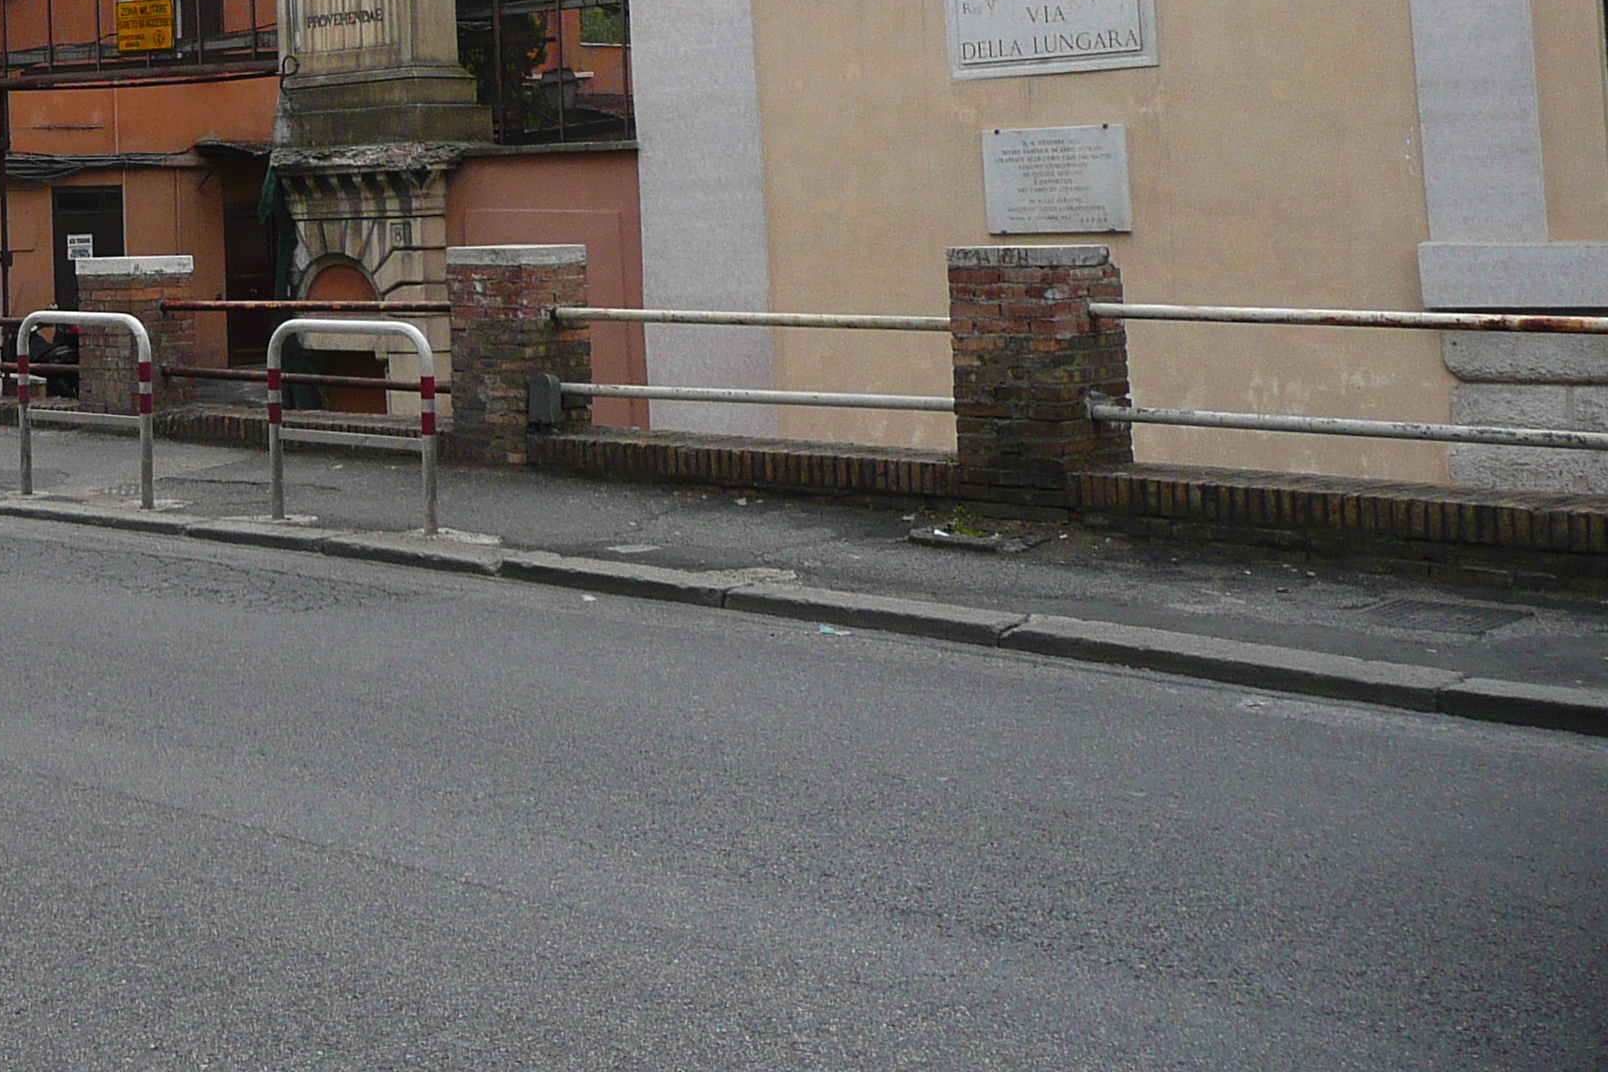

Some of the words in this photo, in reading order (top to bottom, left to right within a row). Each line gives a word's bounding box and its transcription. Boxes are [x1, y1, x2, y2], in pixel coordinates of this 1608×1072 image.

[1026, 4, 1066, 24] VIA
[962, 39, 1022, 60] DELLA
[1033, 29, 1138, 55] LUNGARA
